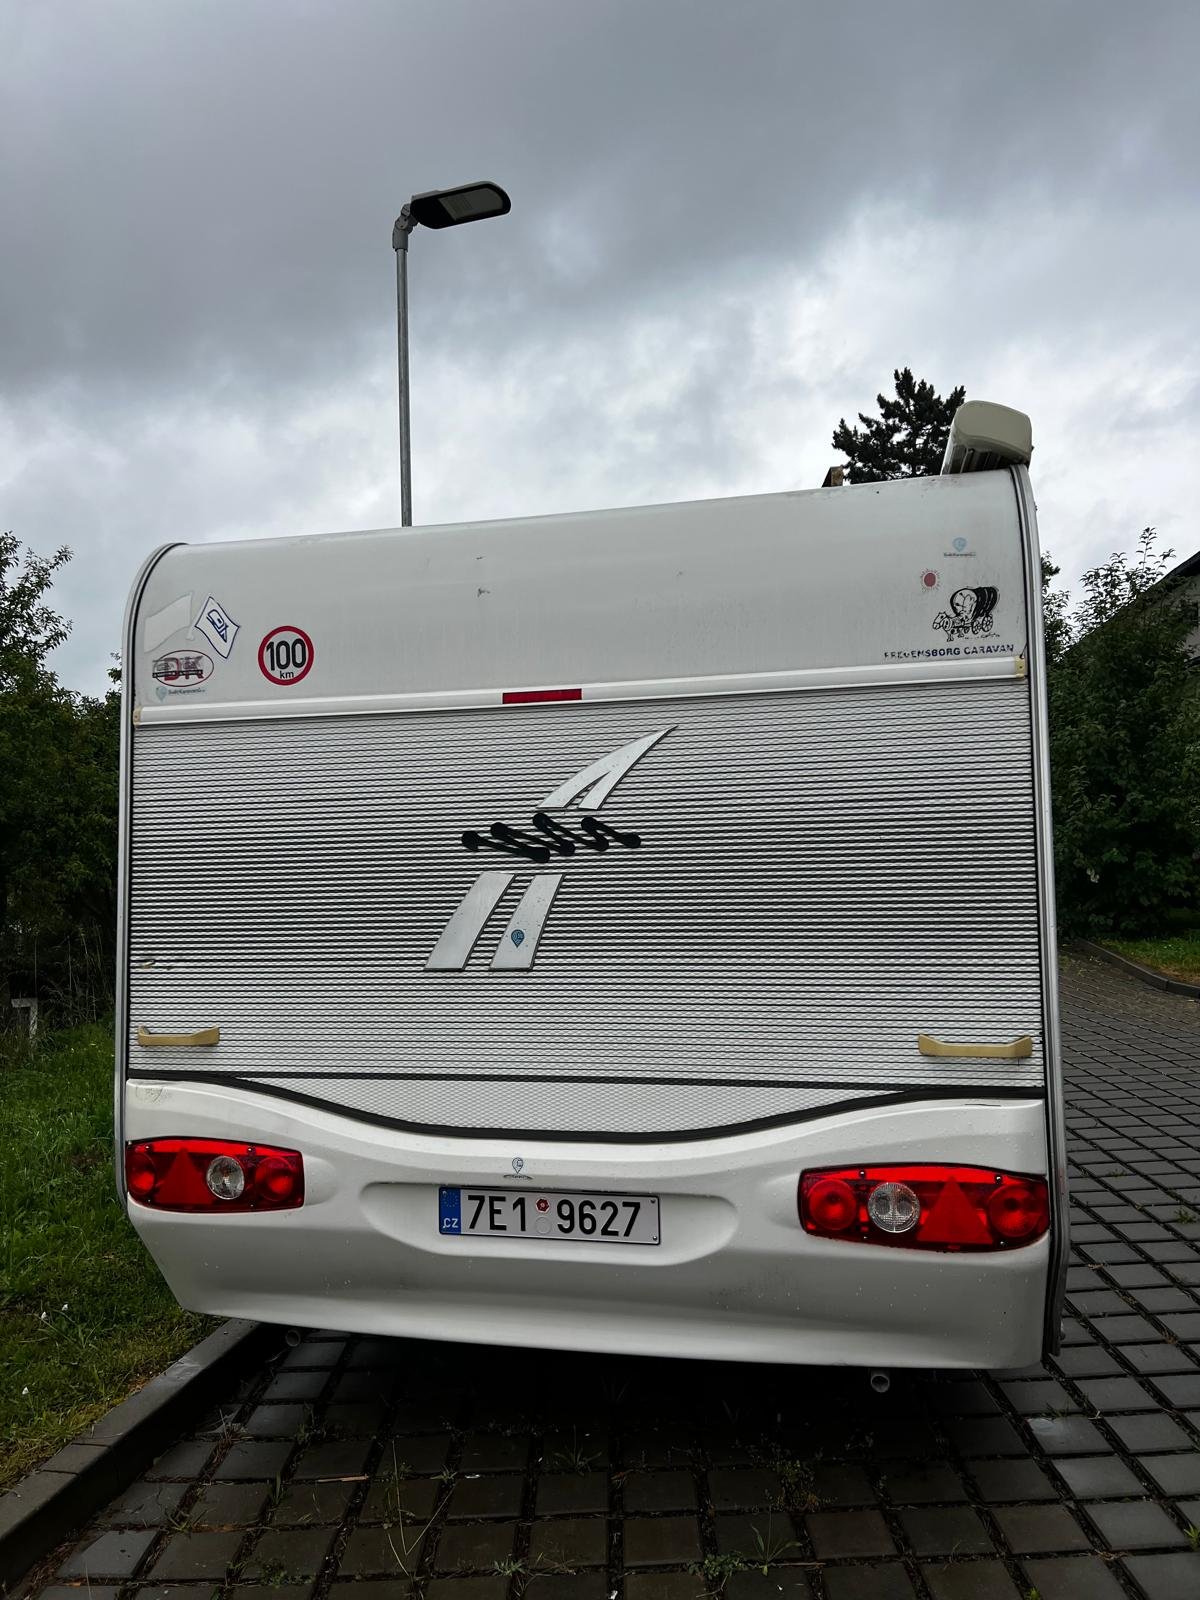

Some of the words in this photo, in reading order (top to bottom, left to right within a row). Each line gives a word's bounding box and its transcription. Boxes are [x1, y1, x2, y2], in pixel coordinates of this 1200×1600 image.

[265, 637, 307, 671] 100
[963, 644, 1014, 655] CARAVAN
[279, 670, 295, 679] km
[444, 1217, 459, 1229] CZ
[467, 1194, 526, 1231] 7E1
[556, 1198, 641, 1237] 9627
